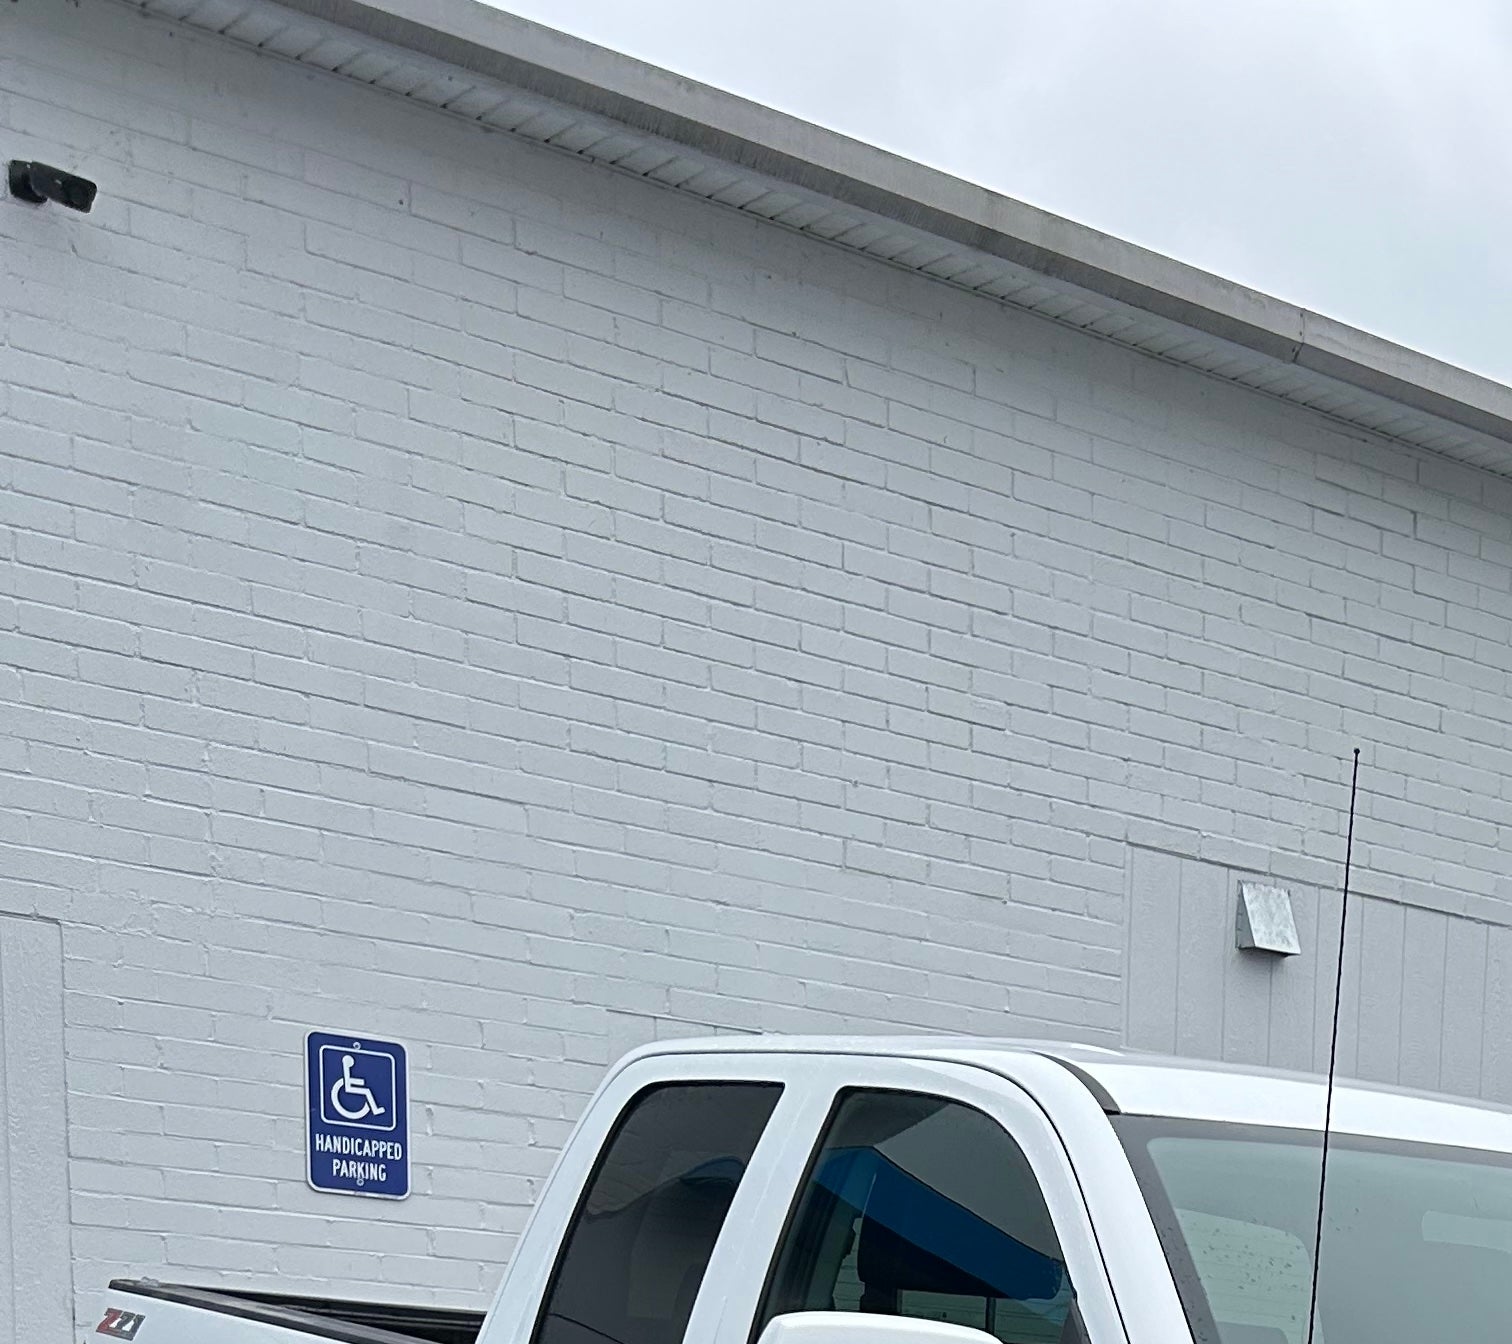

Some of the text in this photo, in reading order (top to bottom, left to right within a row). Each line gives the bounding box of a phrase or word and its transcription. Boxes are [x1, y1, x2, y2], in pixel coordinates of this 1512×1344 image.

[315, 1133, 402, 1160] HANDICAPPED
[332, 1159, 387, 1182] PARKING
[95, 1307, 146, 1341] Z71
